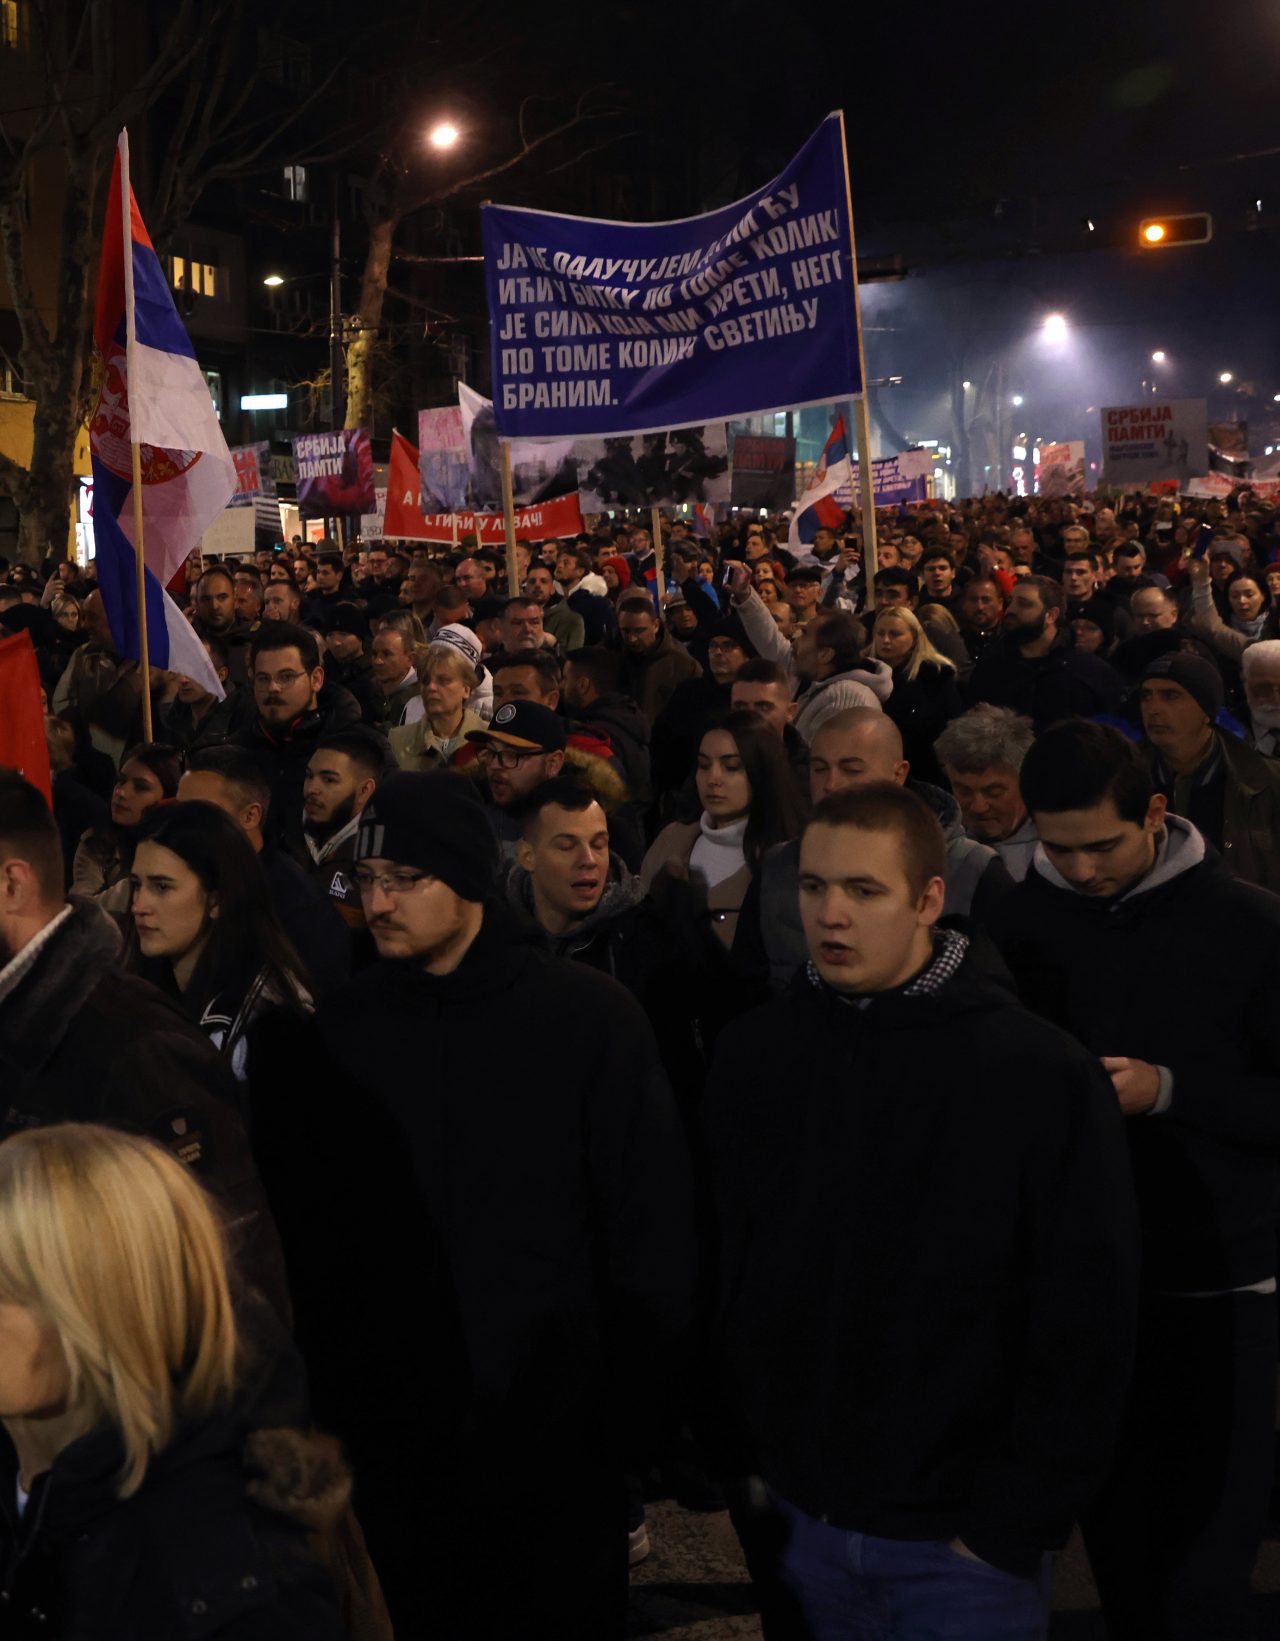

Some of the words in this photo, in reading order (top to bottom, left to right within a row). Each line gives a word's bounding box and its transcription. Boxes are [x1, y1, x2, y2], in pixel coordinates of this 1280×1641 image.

[497, 243, 528, 270] ЈА
[553, 249, 702, 282] ОДЛУЧУЈЕМ
[499, 276, 554, 305] ИЋИ
[569, 281, 641, 310] БИТКУ
[750, 208, 839, 260] КОЛИК
[499, 312, 527, 340] ЈЕ
[534, 310, 602, 338] СИЛА
[597, 313, 659, 336] КОЈА
[655, 307, 705, 334] МИ
[502, 348, 534, 375] ПО
[541, 343, 611, 373] ТОМЕ
[703, 297, 819, 351] СВЕТИЊУ
[503, 378, 619, 409] БРАНИМ.
[1107, 406, 1172, 425] СРБИЈА
[1108, 424, 1165, 442] ПАМТИ
[296, 435, 347, 459] СРБИЈА
[298, 457, 343, 480] ПАМТИ
[492, 511, 543, 531] ЛВАЧ!
